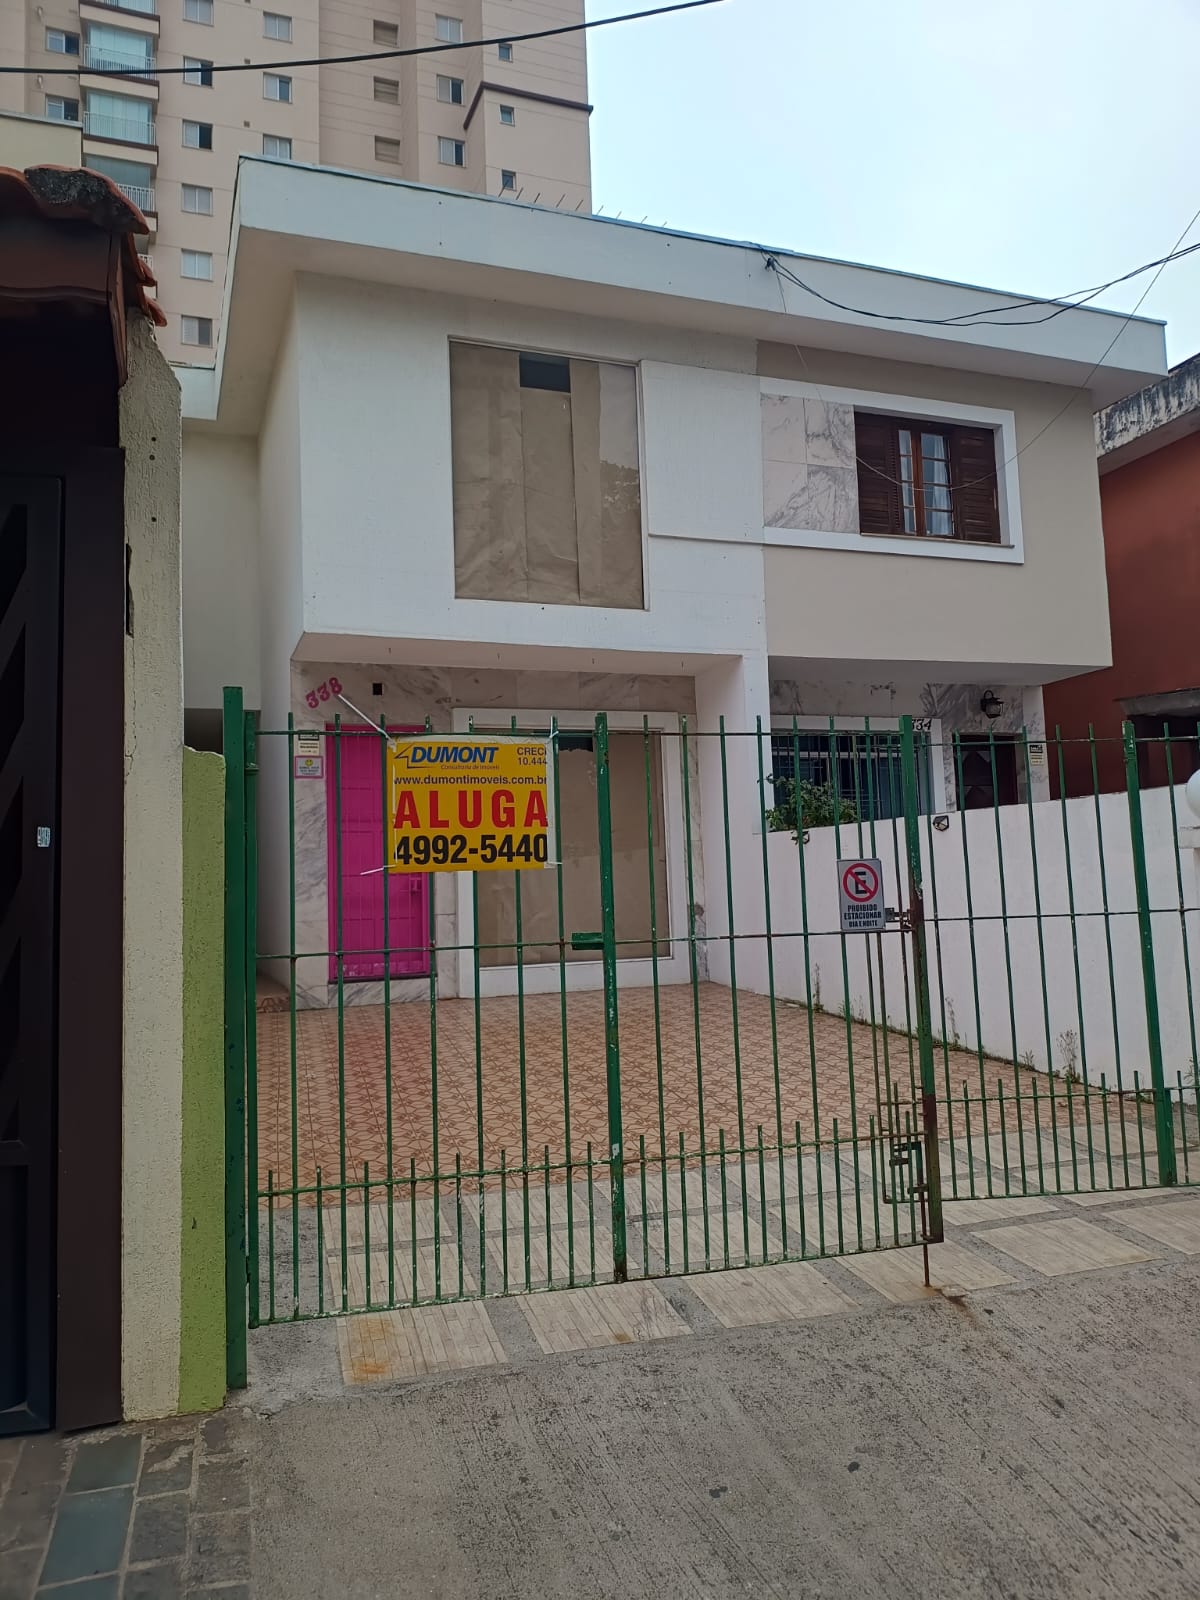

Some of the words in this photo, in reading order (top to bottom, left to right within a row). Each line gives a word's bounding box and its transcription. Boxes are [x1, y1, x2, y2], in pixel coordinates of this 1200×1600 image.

[305, 677, 343, 709] 338
[411, 746, 499, 763] DUMONT
[394, 775, 547, 785] www.dumontimoveis.com.br
[394, 789, 548, 829] ALUGA
[394, 834, 548, 864] 4992-5440
[843, 912, 882, 920] ESTACIONAR
[847, 904, 878, 912] PROIBIDO
